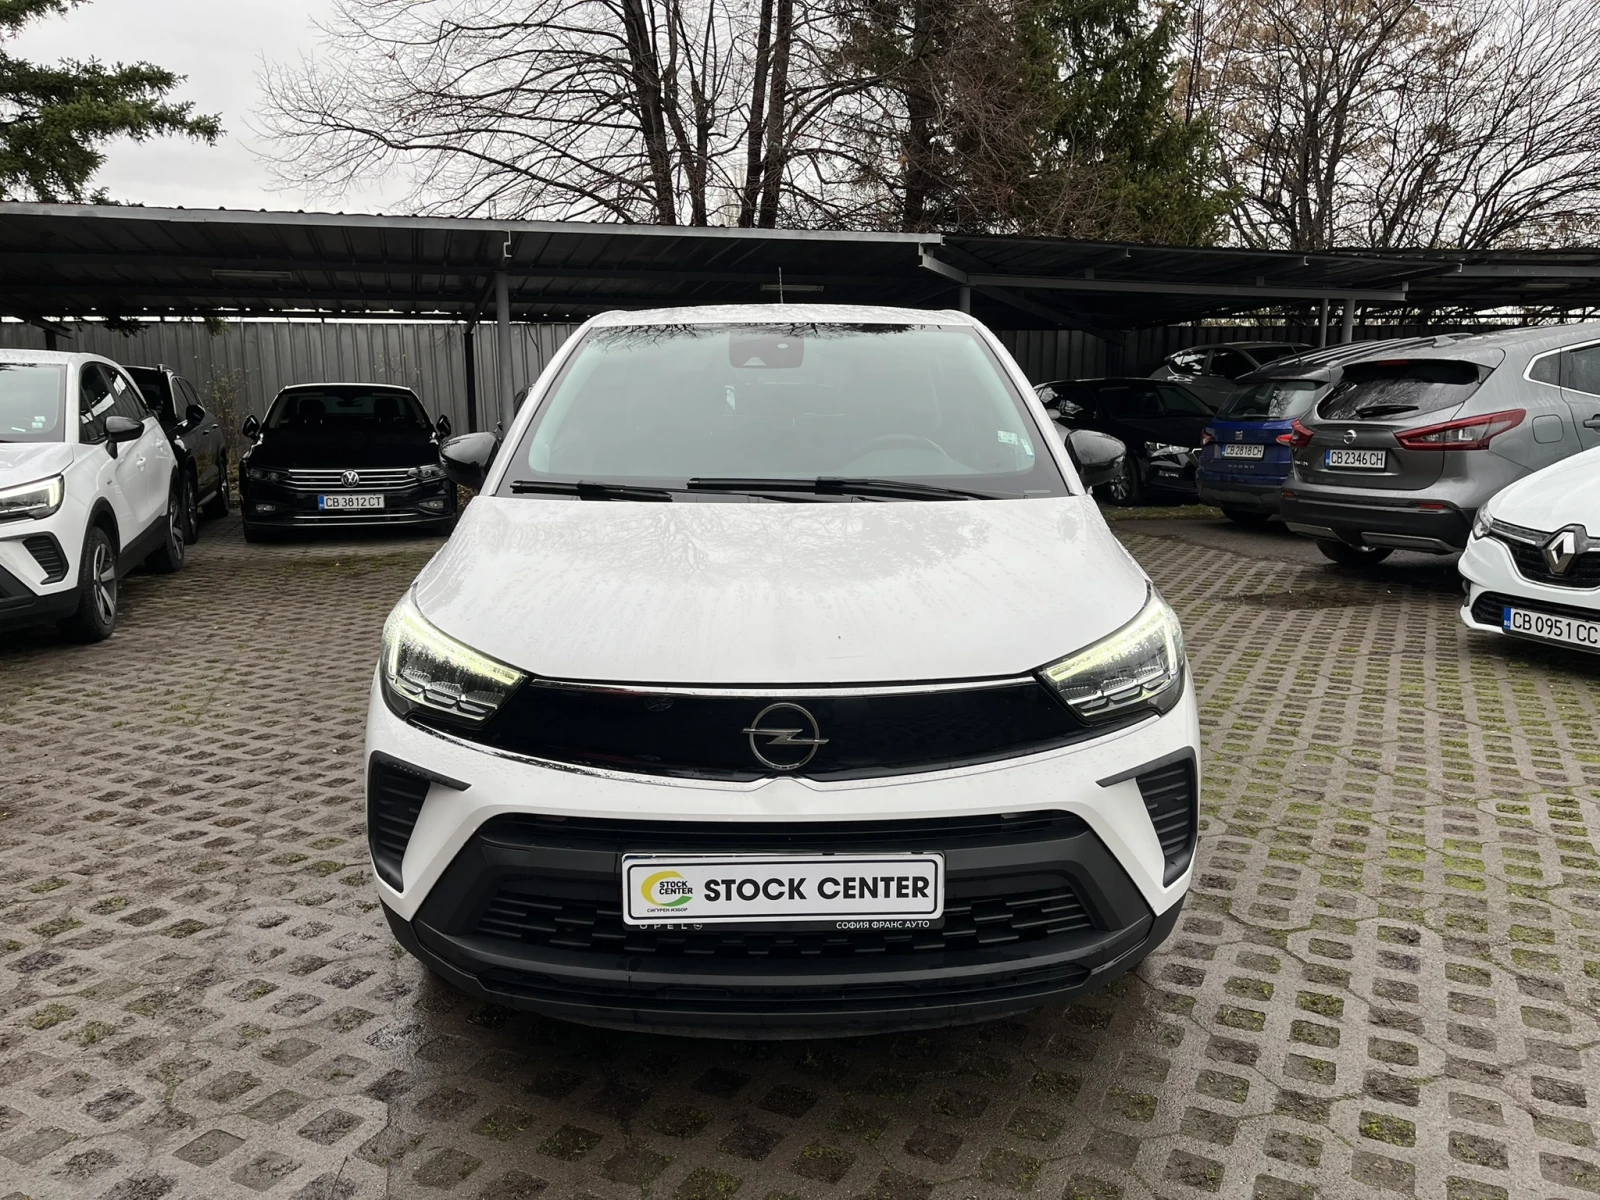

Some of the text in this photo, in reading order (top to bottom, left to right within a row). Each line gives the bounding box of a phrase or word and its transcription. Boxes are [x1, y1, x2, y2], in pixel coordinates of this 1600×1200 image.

[1226, 445, 1263, 456] CB 2818 CH
[1331, 451, 1384, 466] CB 2346 CH
[325, 496, 381, 507] CB 3812 CT
[1513, 612, 1598, 644] CB 0951 CC
[659, 887, 693, 895] CENTER
[704, 875, 930, 901] STOCK CENTER
[836, 920, 930, 929] СОФИЯ ФРАНС АУТО
